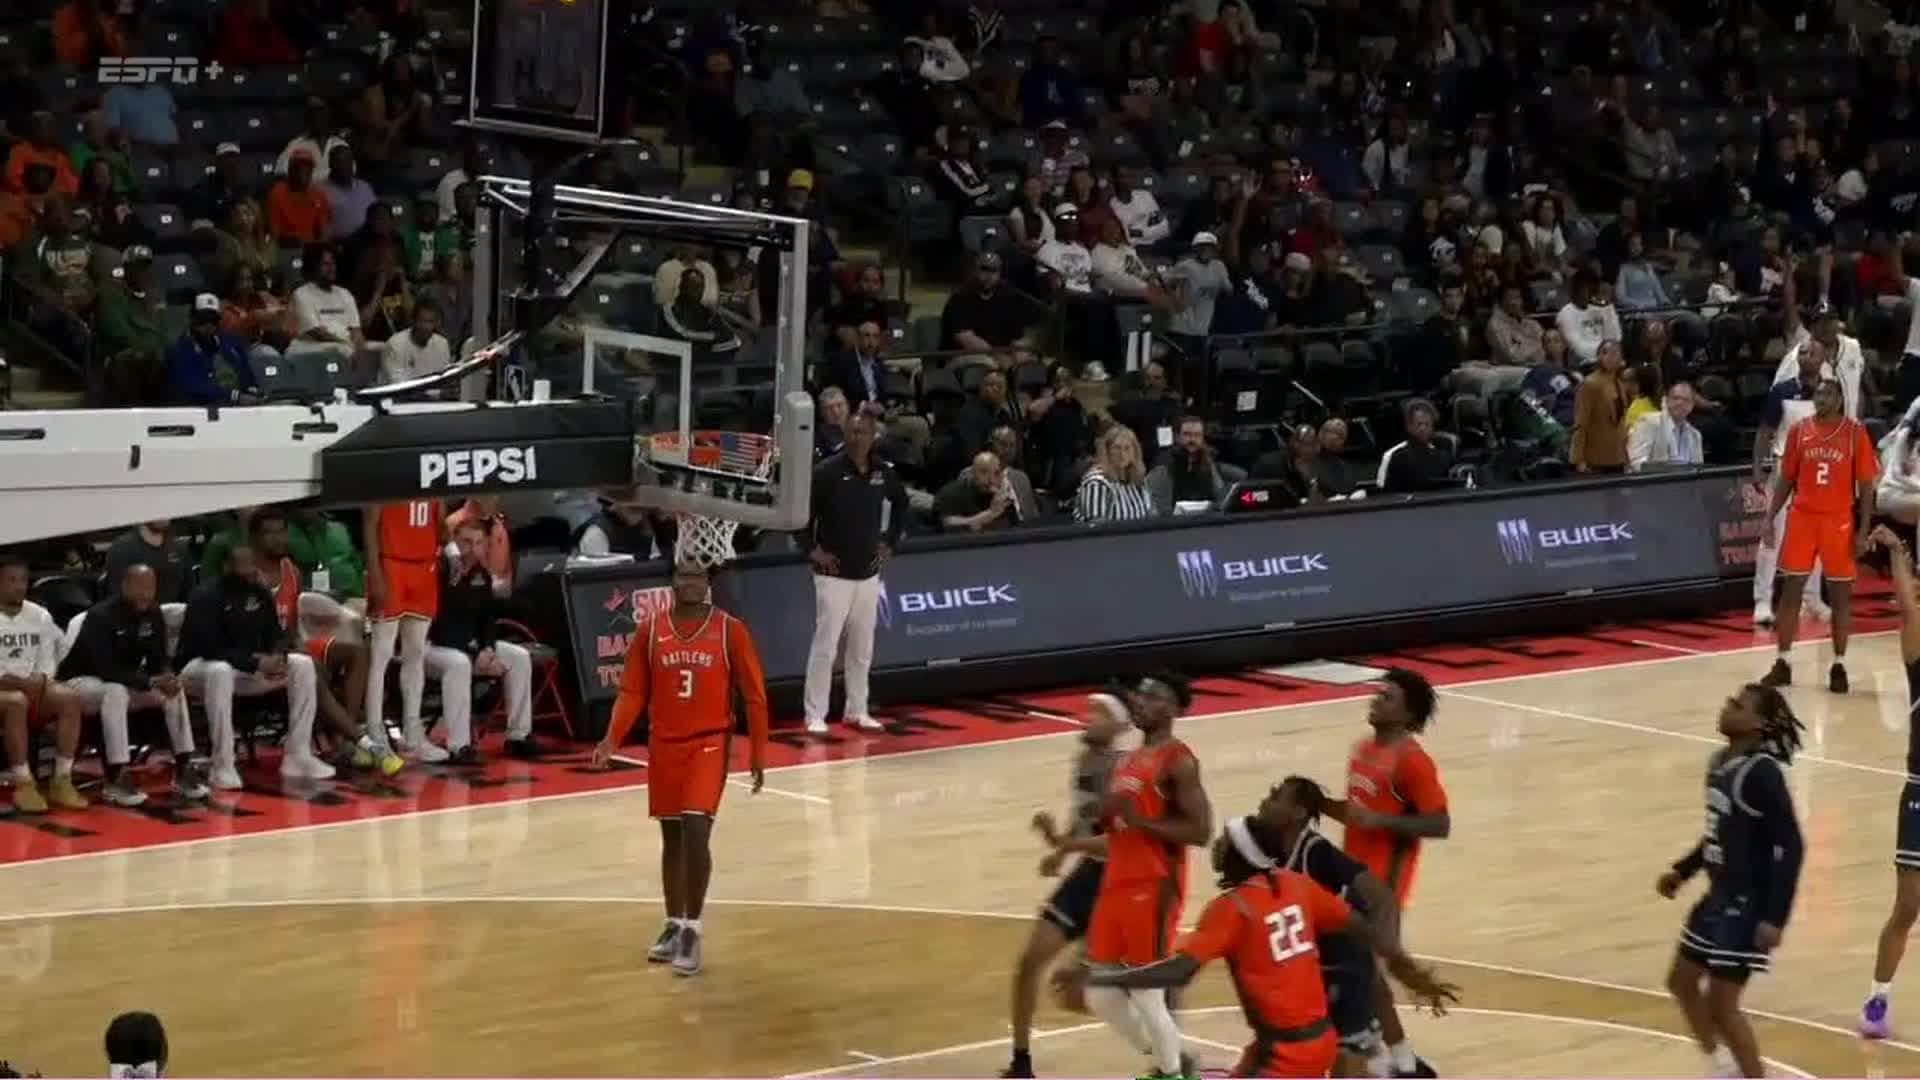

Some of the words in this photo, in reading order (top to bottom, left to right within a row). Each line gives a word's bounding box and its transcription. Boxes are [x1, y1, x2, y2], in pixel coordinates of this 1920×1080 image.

[420, 446, 536, 488] PEPSI
[1816, 462, 1829, 485] 2
[409, 500, 429, 527] 10
[1538, 521, 1632, 547] BUICK
[1223, 552, 1328, 580] BUICK
[899, 583, 1016, 613] BUICK
[678, 669, 692, 697] 3
[1264, 904, 1313, 962] 22
